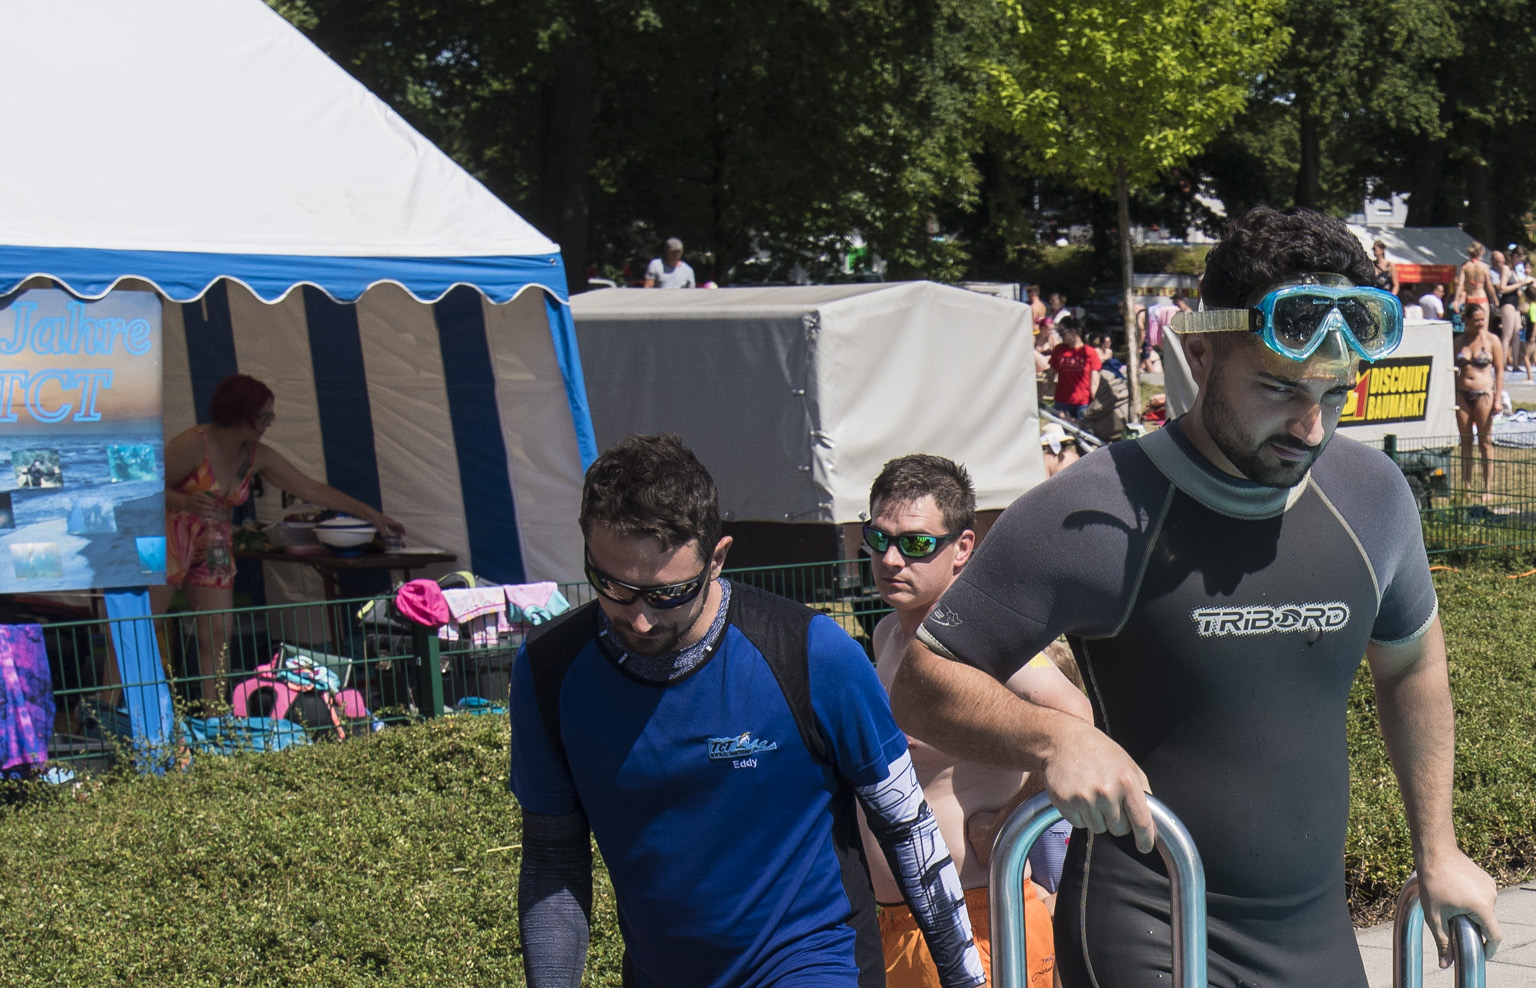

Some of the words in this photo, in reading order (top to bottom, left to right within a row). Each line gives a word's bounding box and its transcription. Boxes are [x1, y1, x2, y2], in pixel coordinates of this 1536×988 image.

[0, 301, 152, 356] Jahre
[1369, 365, 1430, 394] DISCOUNT
[1366, 392, 1427, 421] BAUMARKT
[711, 740, 736, 752] TCT
[733, 758, 757, 769] Eddy
